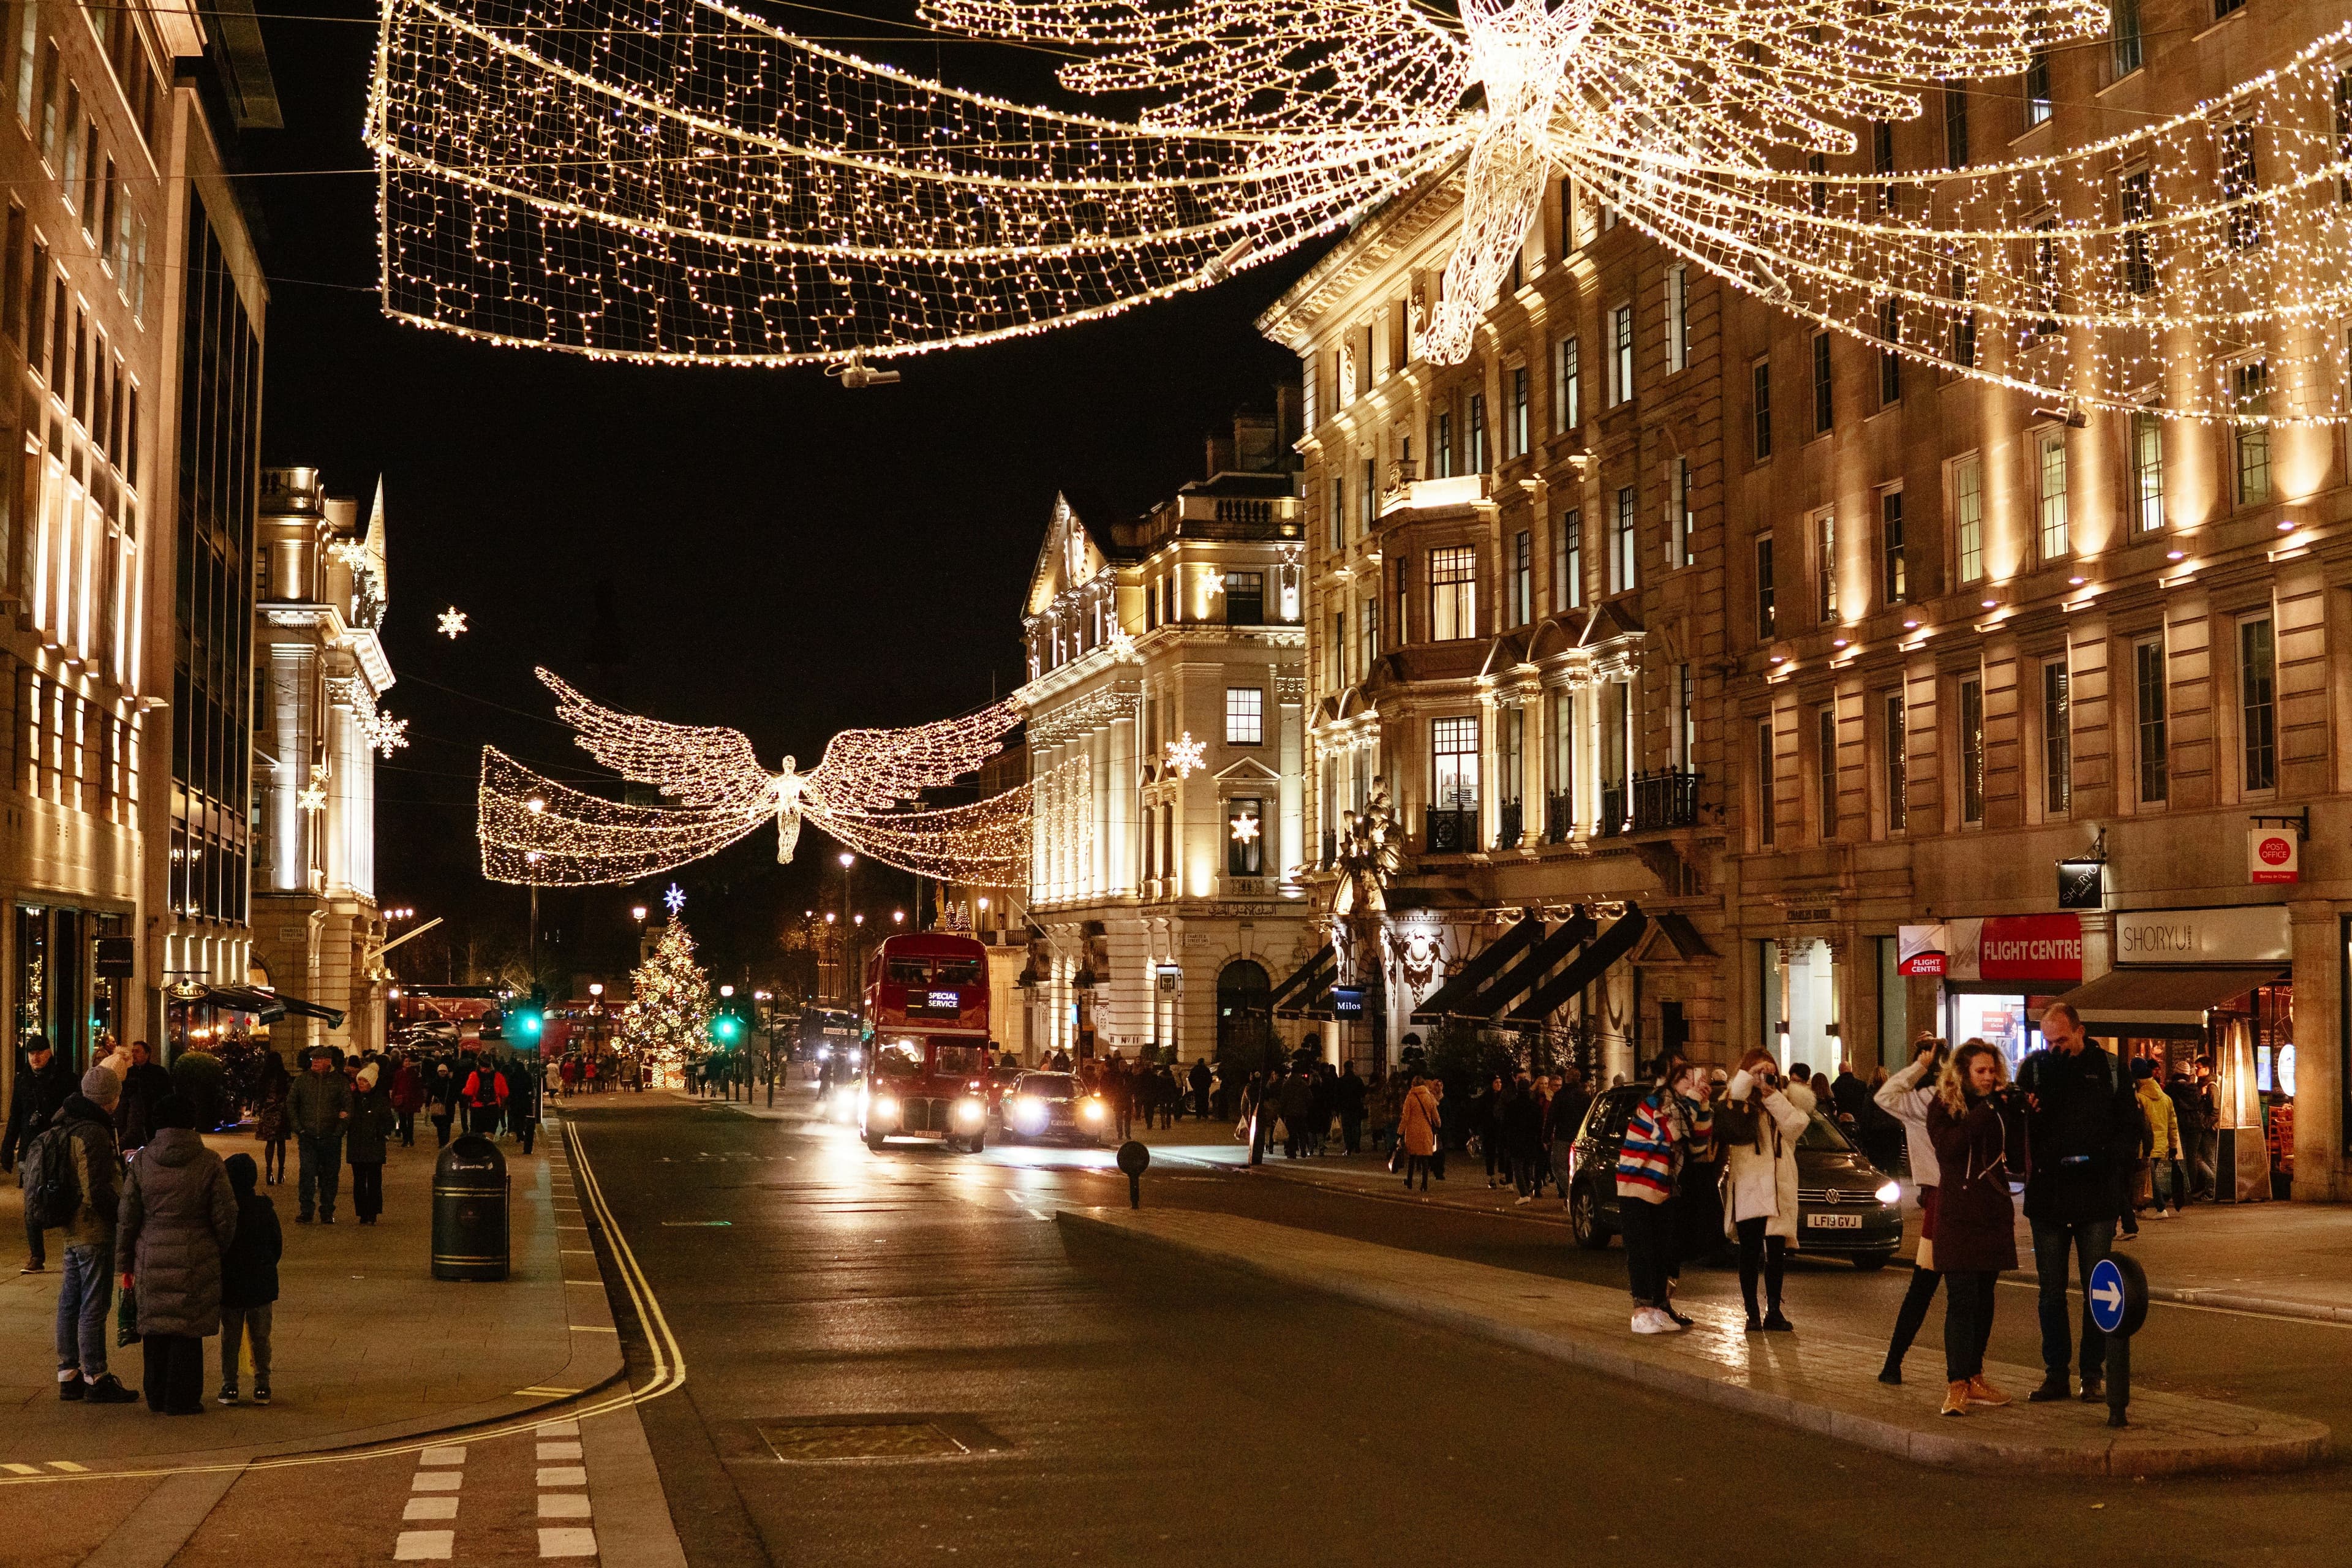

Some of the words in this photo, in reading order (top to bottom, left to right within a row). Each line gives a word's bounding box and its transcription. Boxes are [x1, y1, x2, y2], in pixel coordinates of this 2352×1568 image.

[2062, 865, 2097, 903] SHORYU
[2078, 882, 2093, 898] RAMEN
[2124, 925, 2186, 951] SHORYU
[1984, 940, 2029, 961] FLIGHT
[2030, 938, 2081, 960] CENTRE
[928, 992, 958, 1000] SPECIAL
[1337, 1001, 1361, 1010] Milos
[1814, 1216, 1836, 1227] LF19
[1838, 1216, 1856, 1227] GVJ
